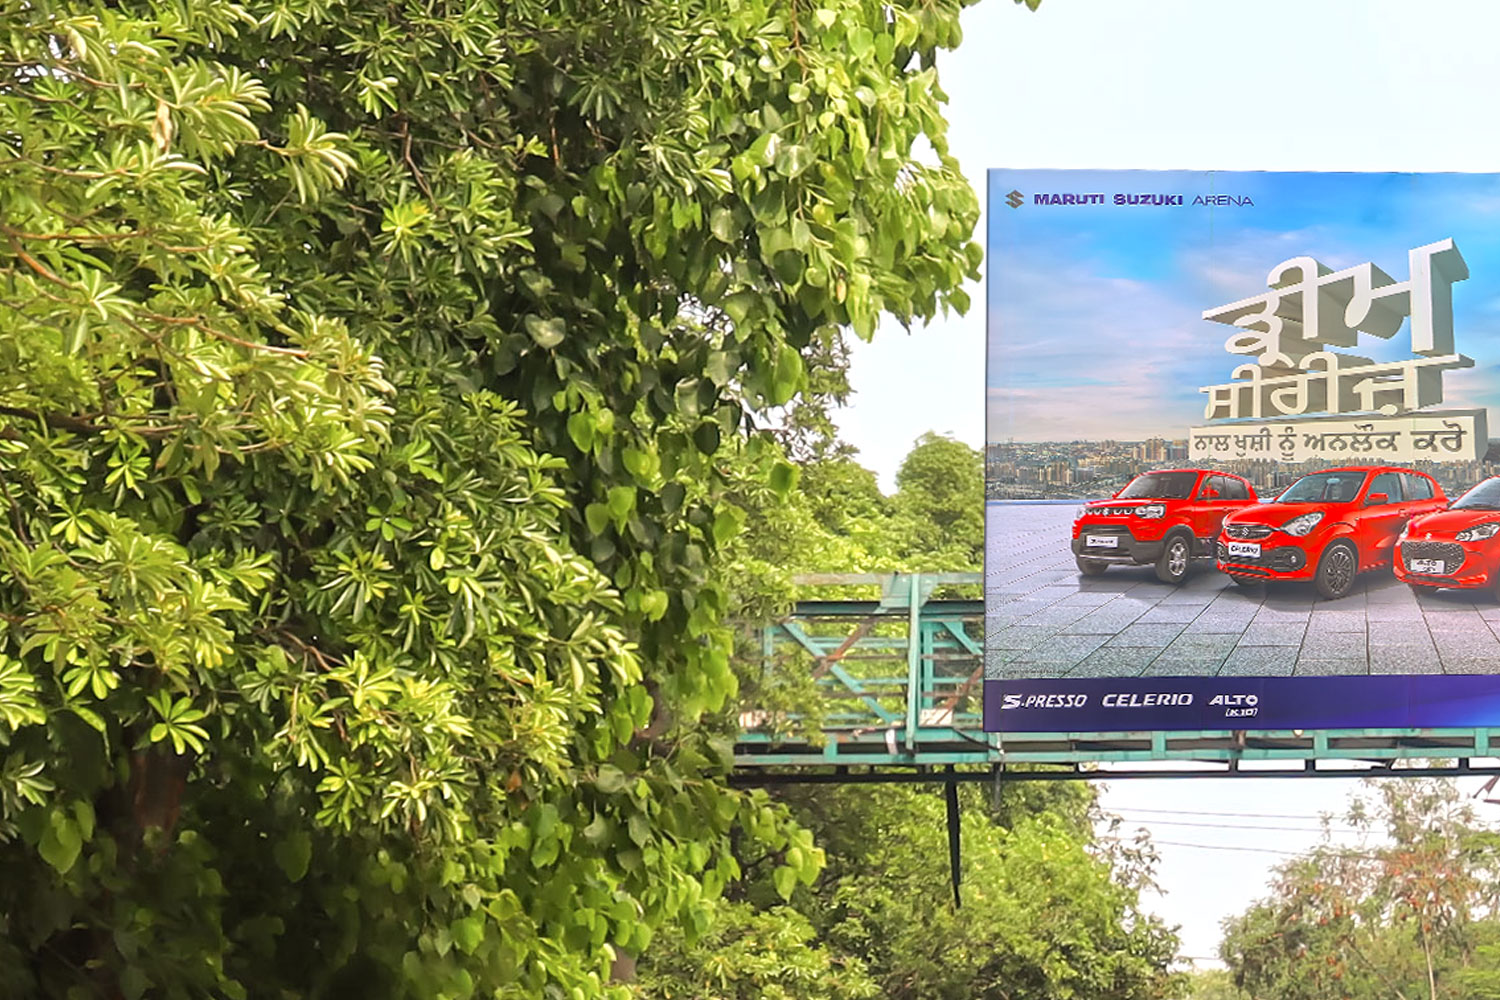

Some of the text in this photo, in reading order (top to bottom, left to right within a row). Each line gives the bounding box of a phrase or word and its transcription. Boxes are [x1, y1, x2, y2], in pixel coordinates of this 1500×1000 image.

[1033, 193, 1255, 207] MARUTI SUZUKI ARENA
[1193, 434, 1231, 452] ਨਾਲ
[1410, 420, 1468, 453] ਕਰੋ
[1102, 693, 1194, 708] CELERIO
[1208, 694, 1259, 706] ALTO
